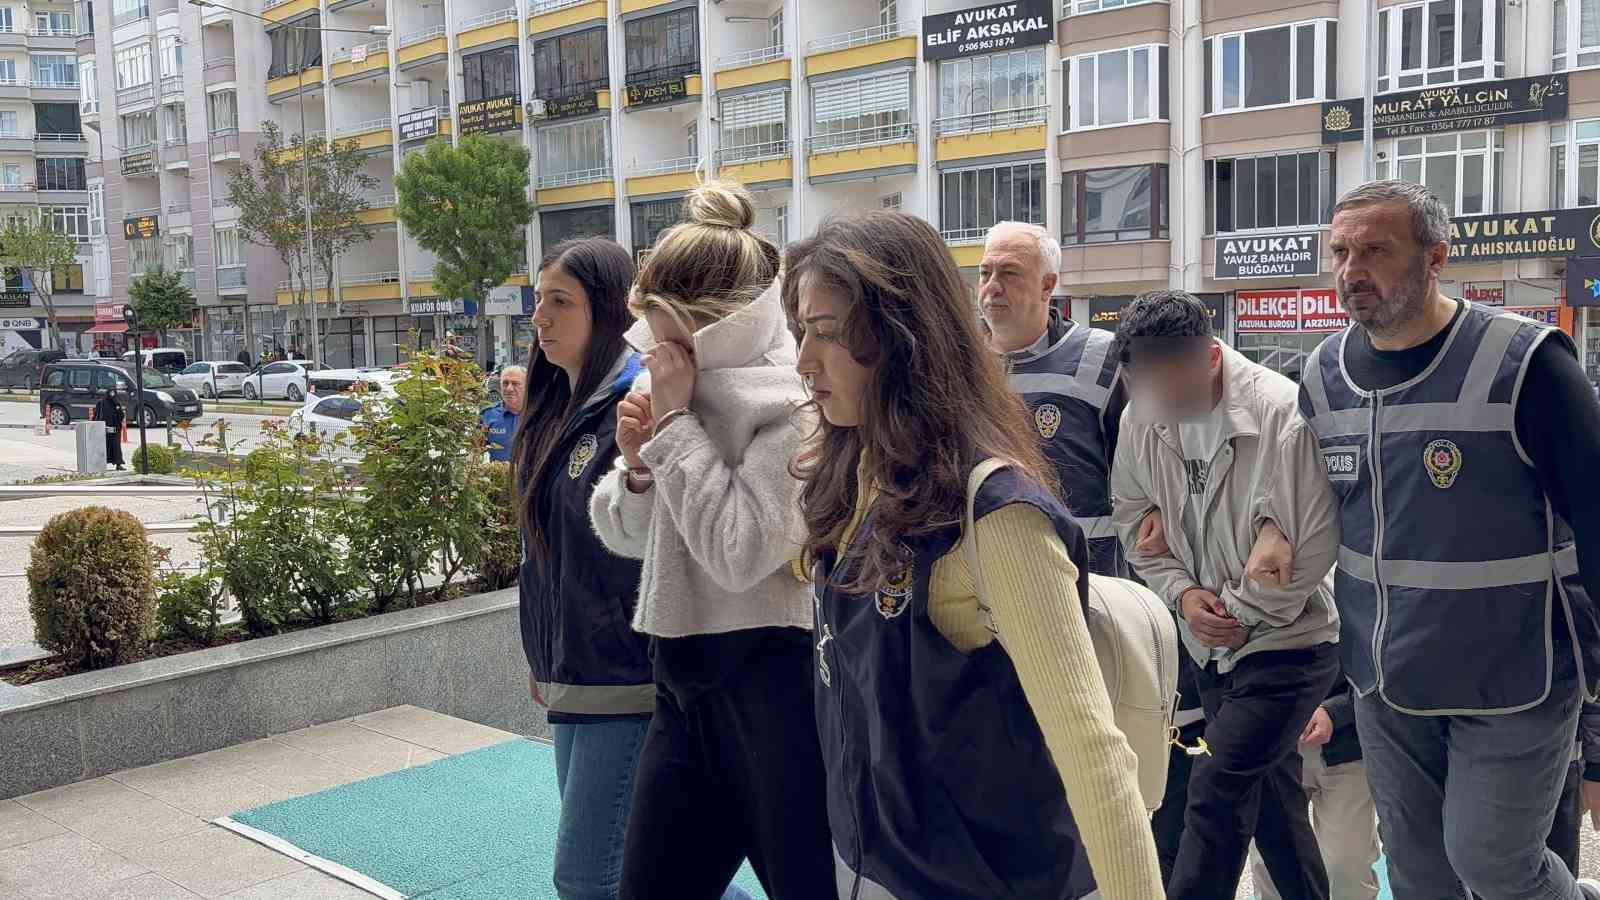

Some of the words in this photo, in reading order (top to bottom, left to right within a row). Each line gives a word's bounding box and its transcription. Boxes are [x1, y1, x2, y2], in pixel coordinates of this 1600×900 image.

[955, 5, 1017, 25] AVUKAT
[927, 29, 962, 46] ELİF
[966, 16, 1048, 40] AKSAKAL
[1420, 87, 1460, 99] AVUKAT
[460, 102, 485, 114] AVUKAT
[486, 97, 513, 110] AVUKAT
[1374, 97, 1435, 115] MURAT
[1386, 128, 1398, 136] Tel
[1410, 125, 1424, 134] Fax
[1449, 216, 1556, 239] AVUKAT
[1223, 236, 1312, 254] AVUKAT
[1223, 254, 1258, 265] YAVUZ
[1260, 251, 1311, 263] BAHADIR
[1238, 263, 1294, 275] BUĞDAYLI
[1237, 297, 1297, 318] DİLEKÇE
[1239, 320, 1268, 328] ARZUHAL
[1305, 318, 1347, 328] ARZUHAL
